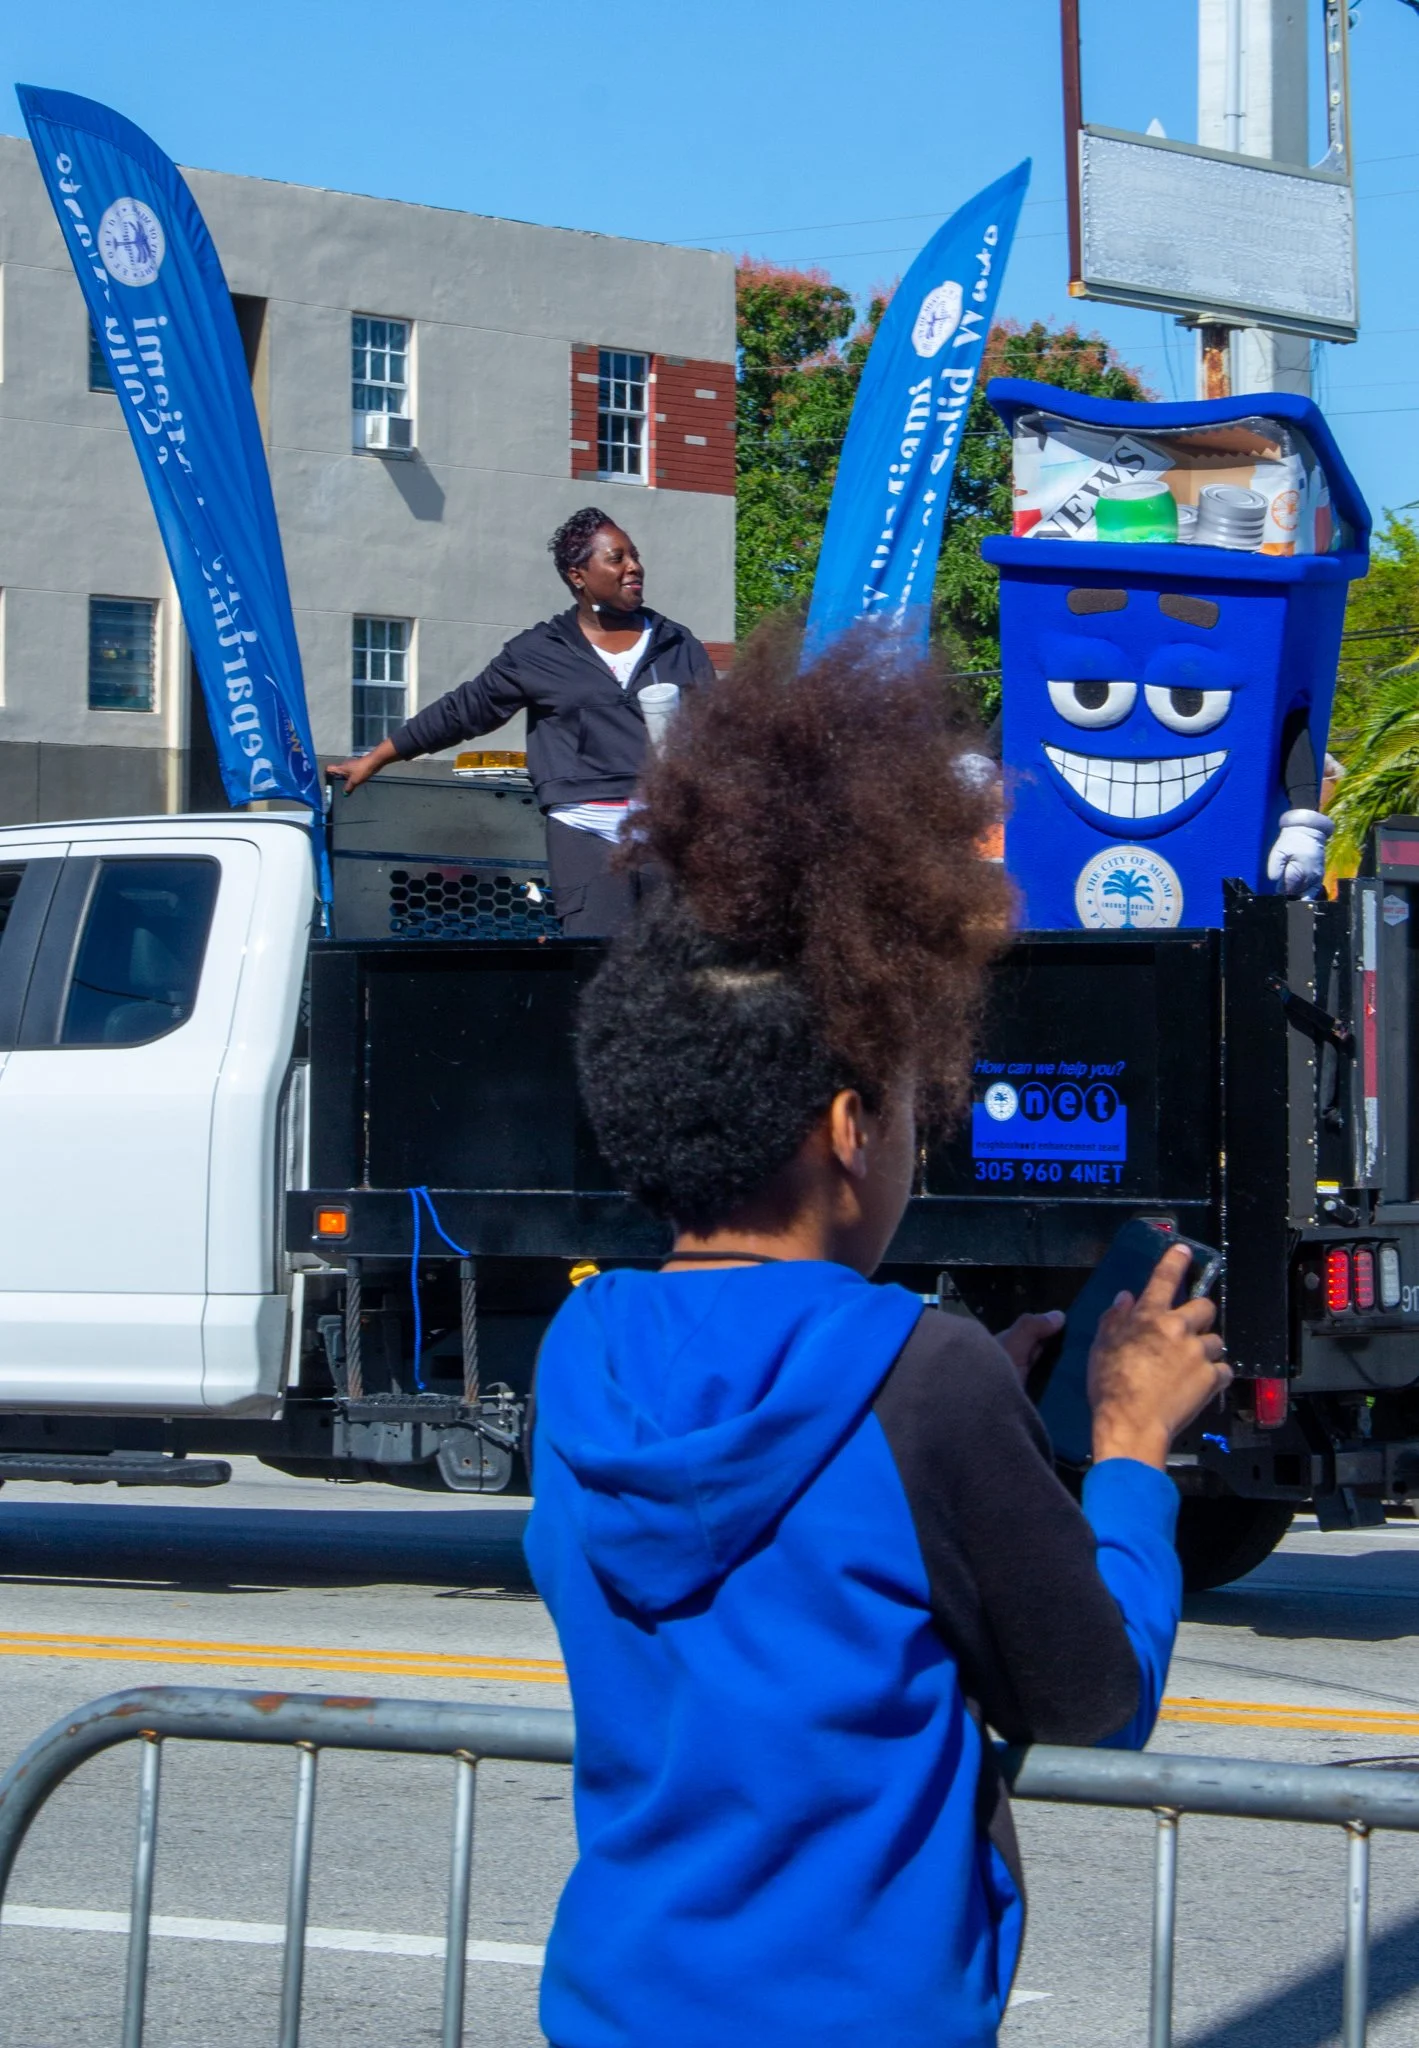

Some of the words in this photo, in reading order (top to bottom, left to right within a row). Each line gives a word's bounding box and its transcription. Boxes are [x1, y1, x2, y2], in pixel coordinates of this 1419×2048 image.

[1086, 871, 1102, 893] THE
[1101, 856, 1127, 872] CITY
[1130, 856, 1147, 867] OF
[1148, 863, 1173, 898] MIAMI
[974, 1059, 1006, 1075] How
[1008, 1062, 1032, 1075] can
[1035, 1062, 1055, 1075] we
[1057, 1060, 1086, 1079] help
[1088, 1060, 1126, 1079] you?
[1024, 1089, 1109, 1120] net
[974, 1161, 1015, 1181] 305
[1022, 1162, 1063, 1182] 960
[1070, 1163, 1125, 1184] 4NET
